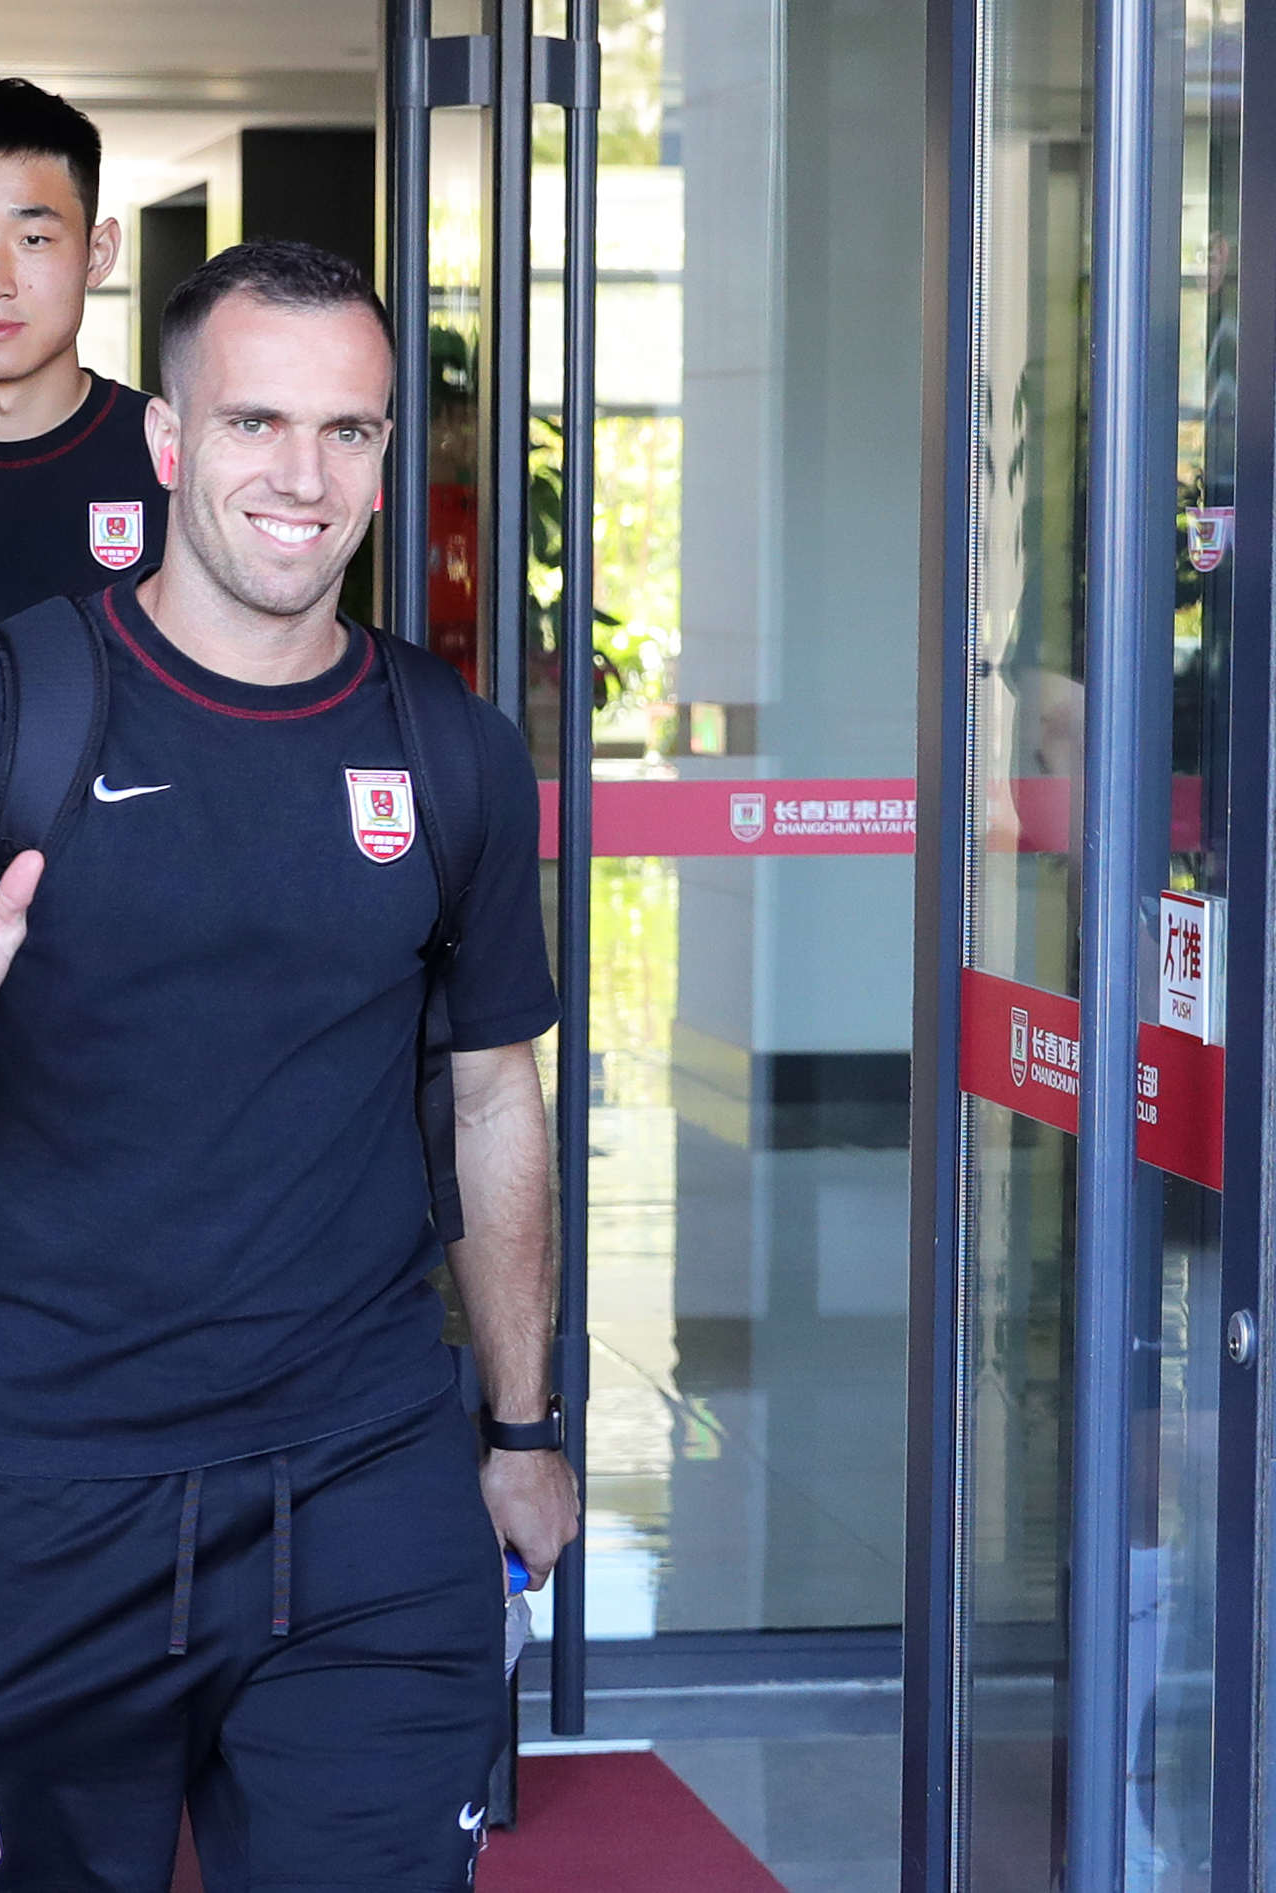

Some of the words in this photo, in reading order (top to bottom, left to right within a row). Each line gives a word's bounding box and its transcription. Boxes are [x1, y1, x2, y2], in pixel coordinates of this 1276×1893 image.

[774, 821, 861, 835] CHANGCHUN
[862, 821, 902, 834] YATAI
[1183, 918, 1202, 981] 推
[1172, 999, 1191, 1021] PUSH
[1031, 1063, 1075, 1096] CHANGCHUN
[1136, 1100, 1158, 1125] CLUB
